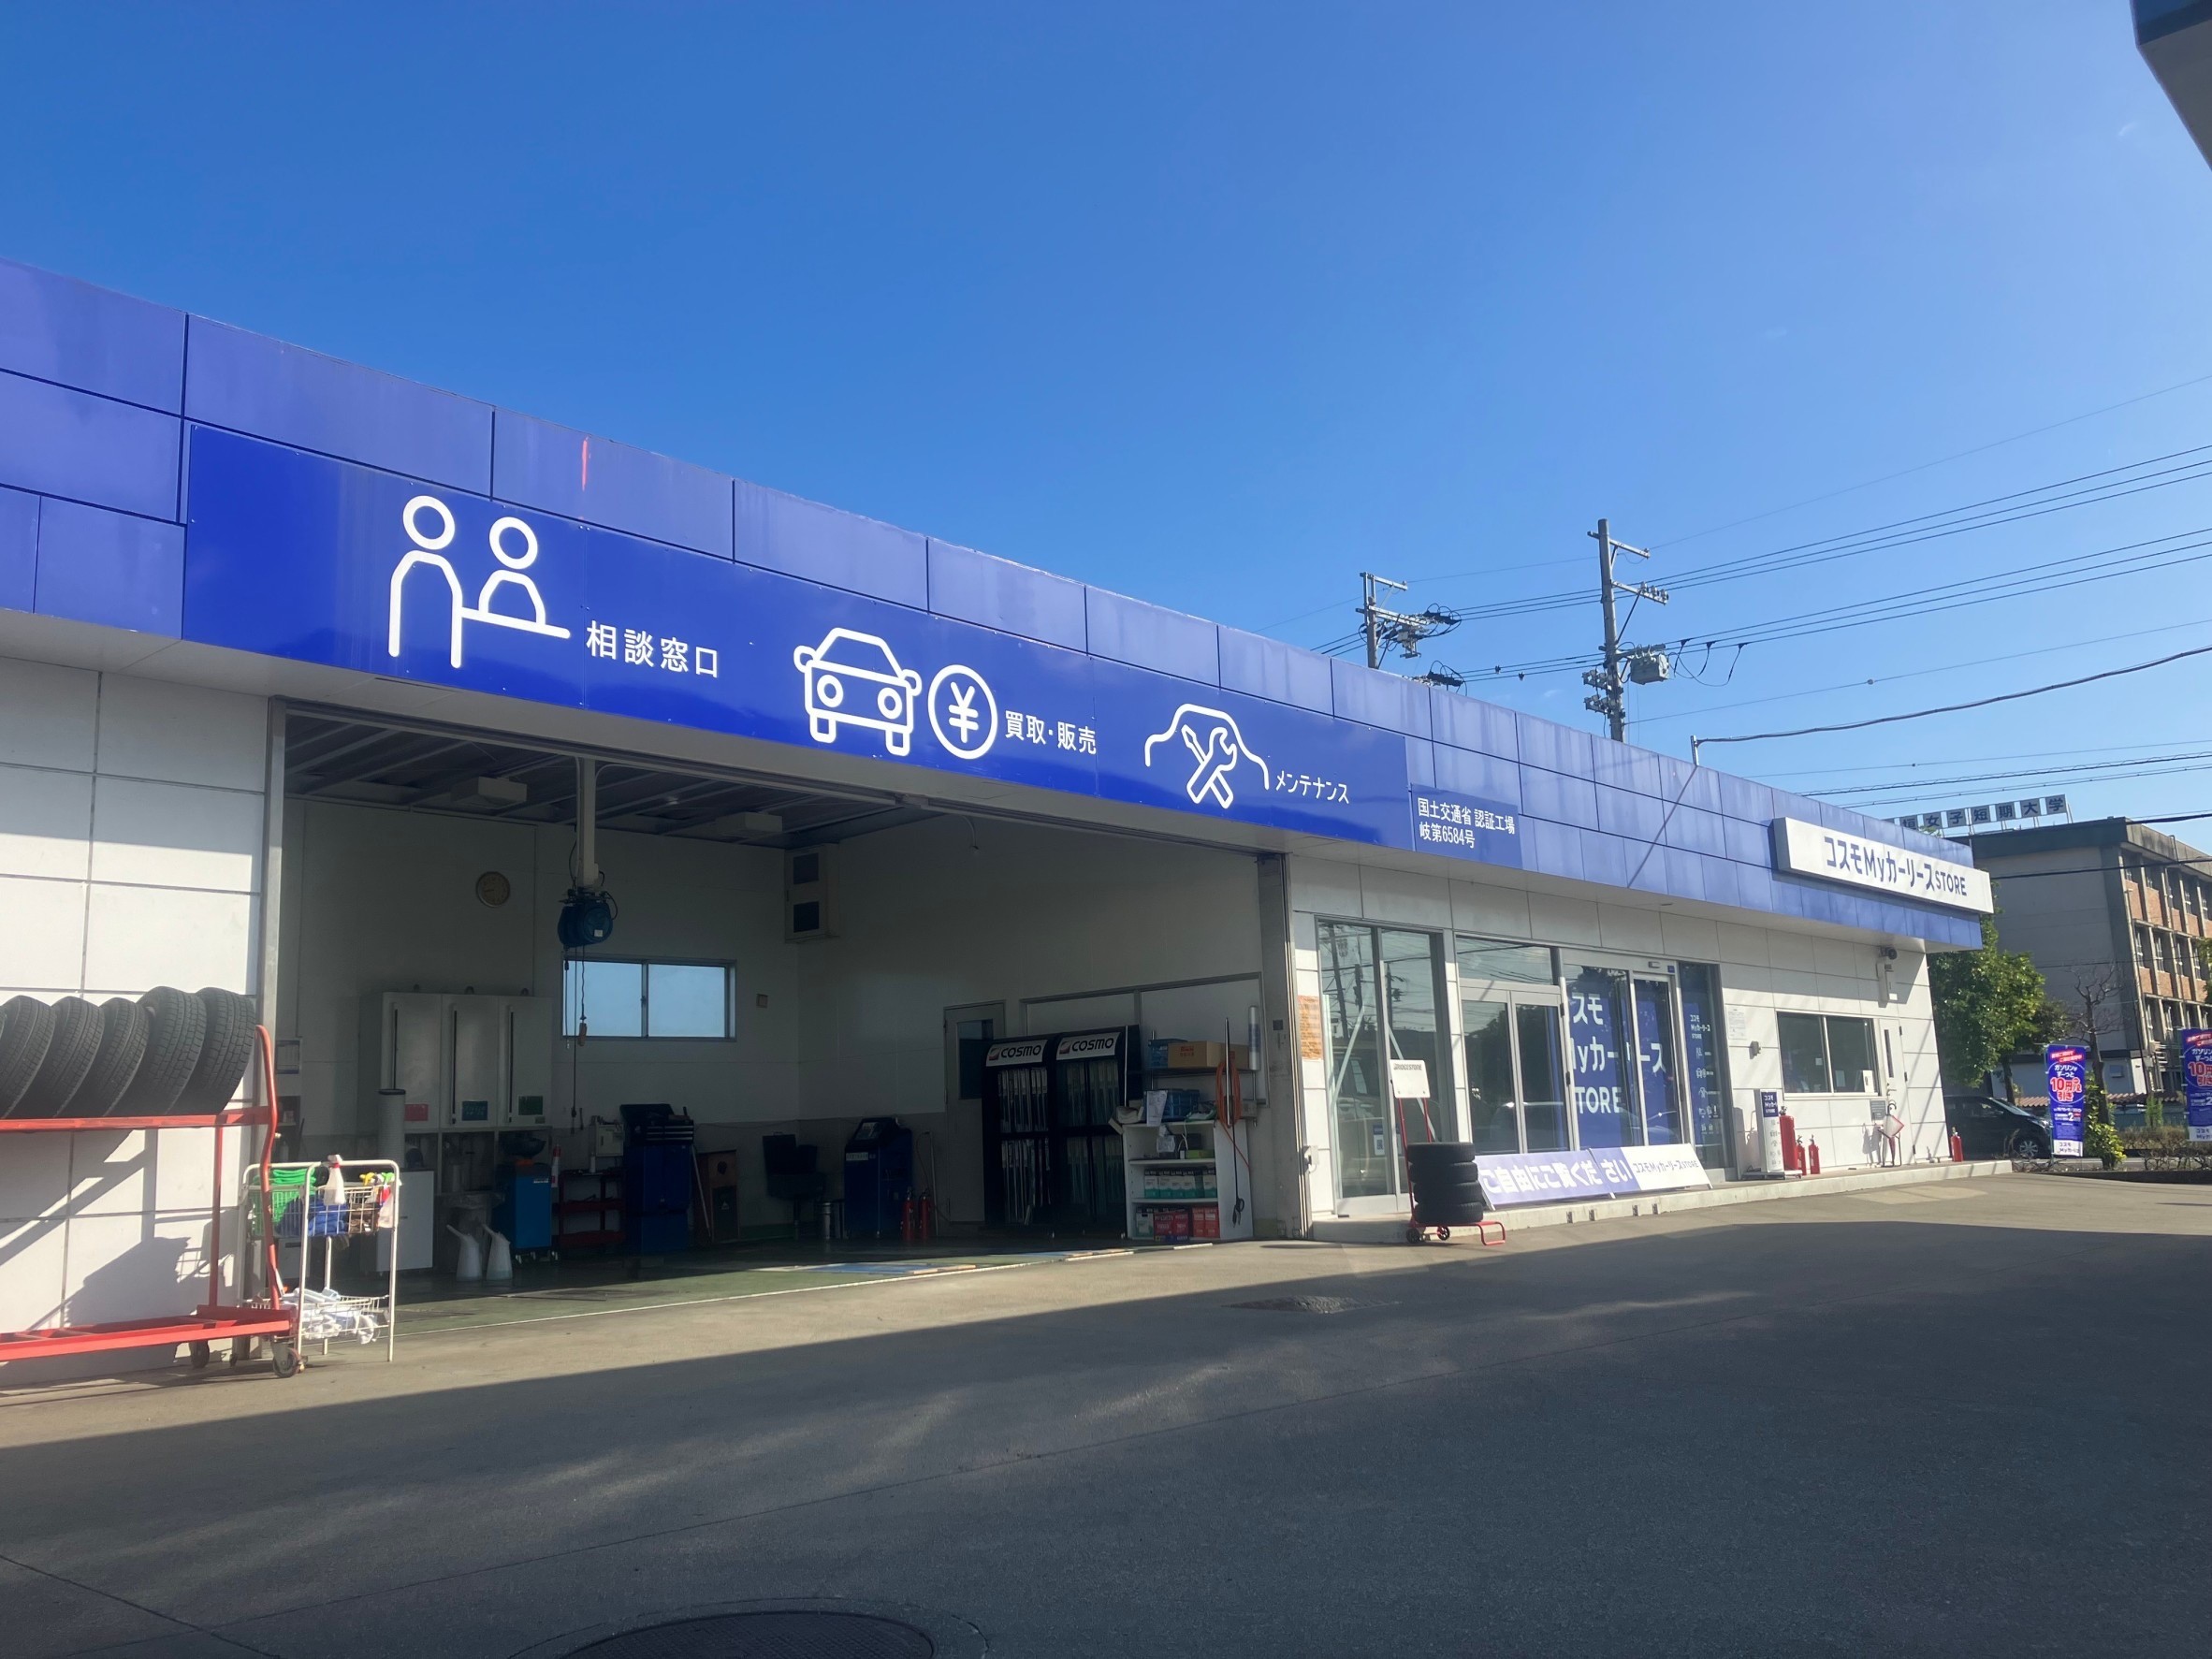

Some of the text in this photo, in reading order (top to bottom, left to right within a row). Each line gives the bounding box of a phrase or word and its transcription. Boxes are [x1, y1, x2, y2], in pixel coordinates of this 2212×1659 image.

[586, 619, 718, 678] 相談窓口
[1005, 709, 1097, 755] 買取・販売
[1275, 770, 1349, 805] メンテナンス
[1418, 797, 1516, 835] 国土交通省 認証工場
[1419, 822, 1476, 849] 岐第6584号
[1571, 993, 1604, 1026] スモ
[1000, 1043, 1041, 1059] COSMO
[1071, 1037, 1114, 1053] COSMO
[1574, 1086, 1622, 1114] TORE
